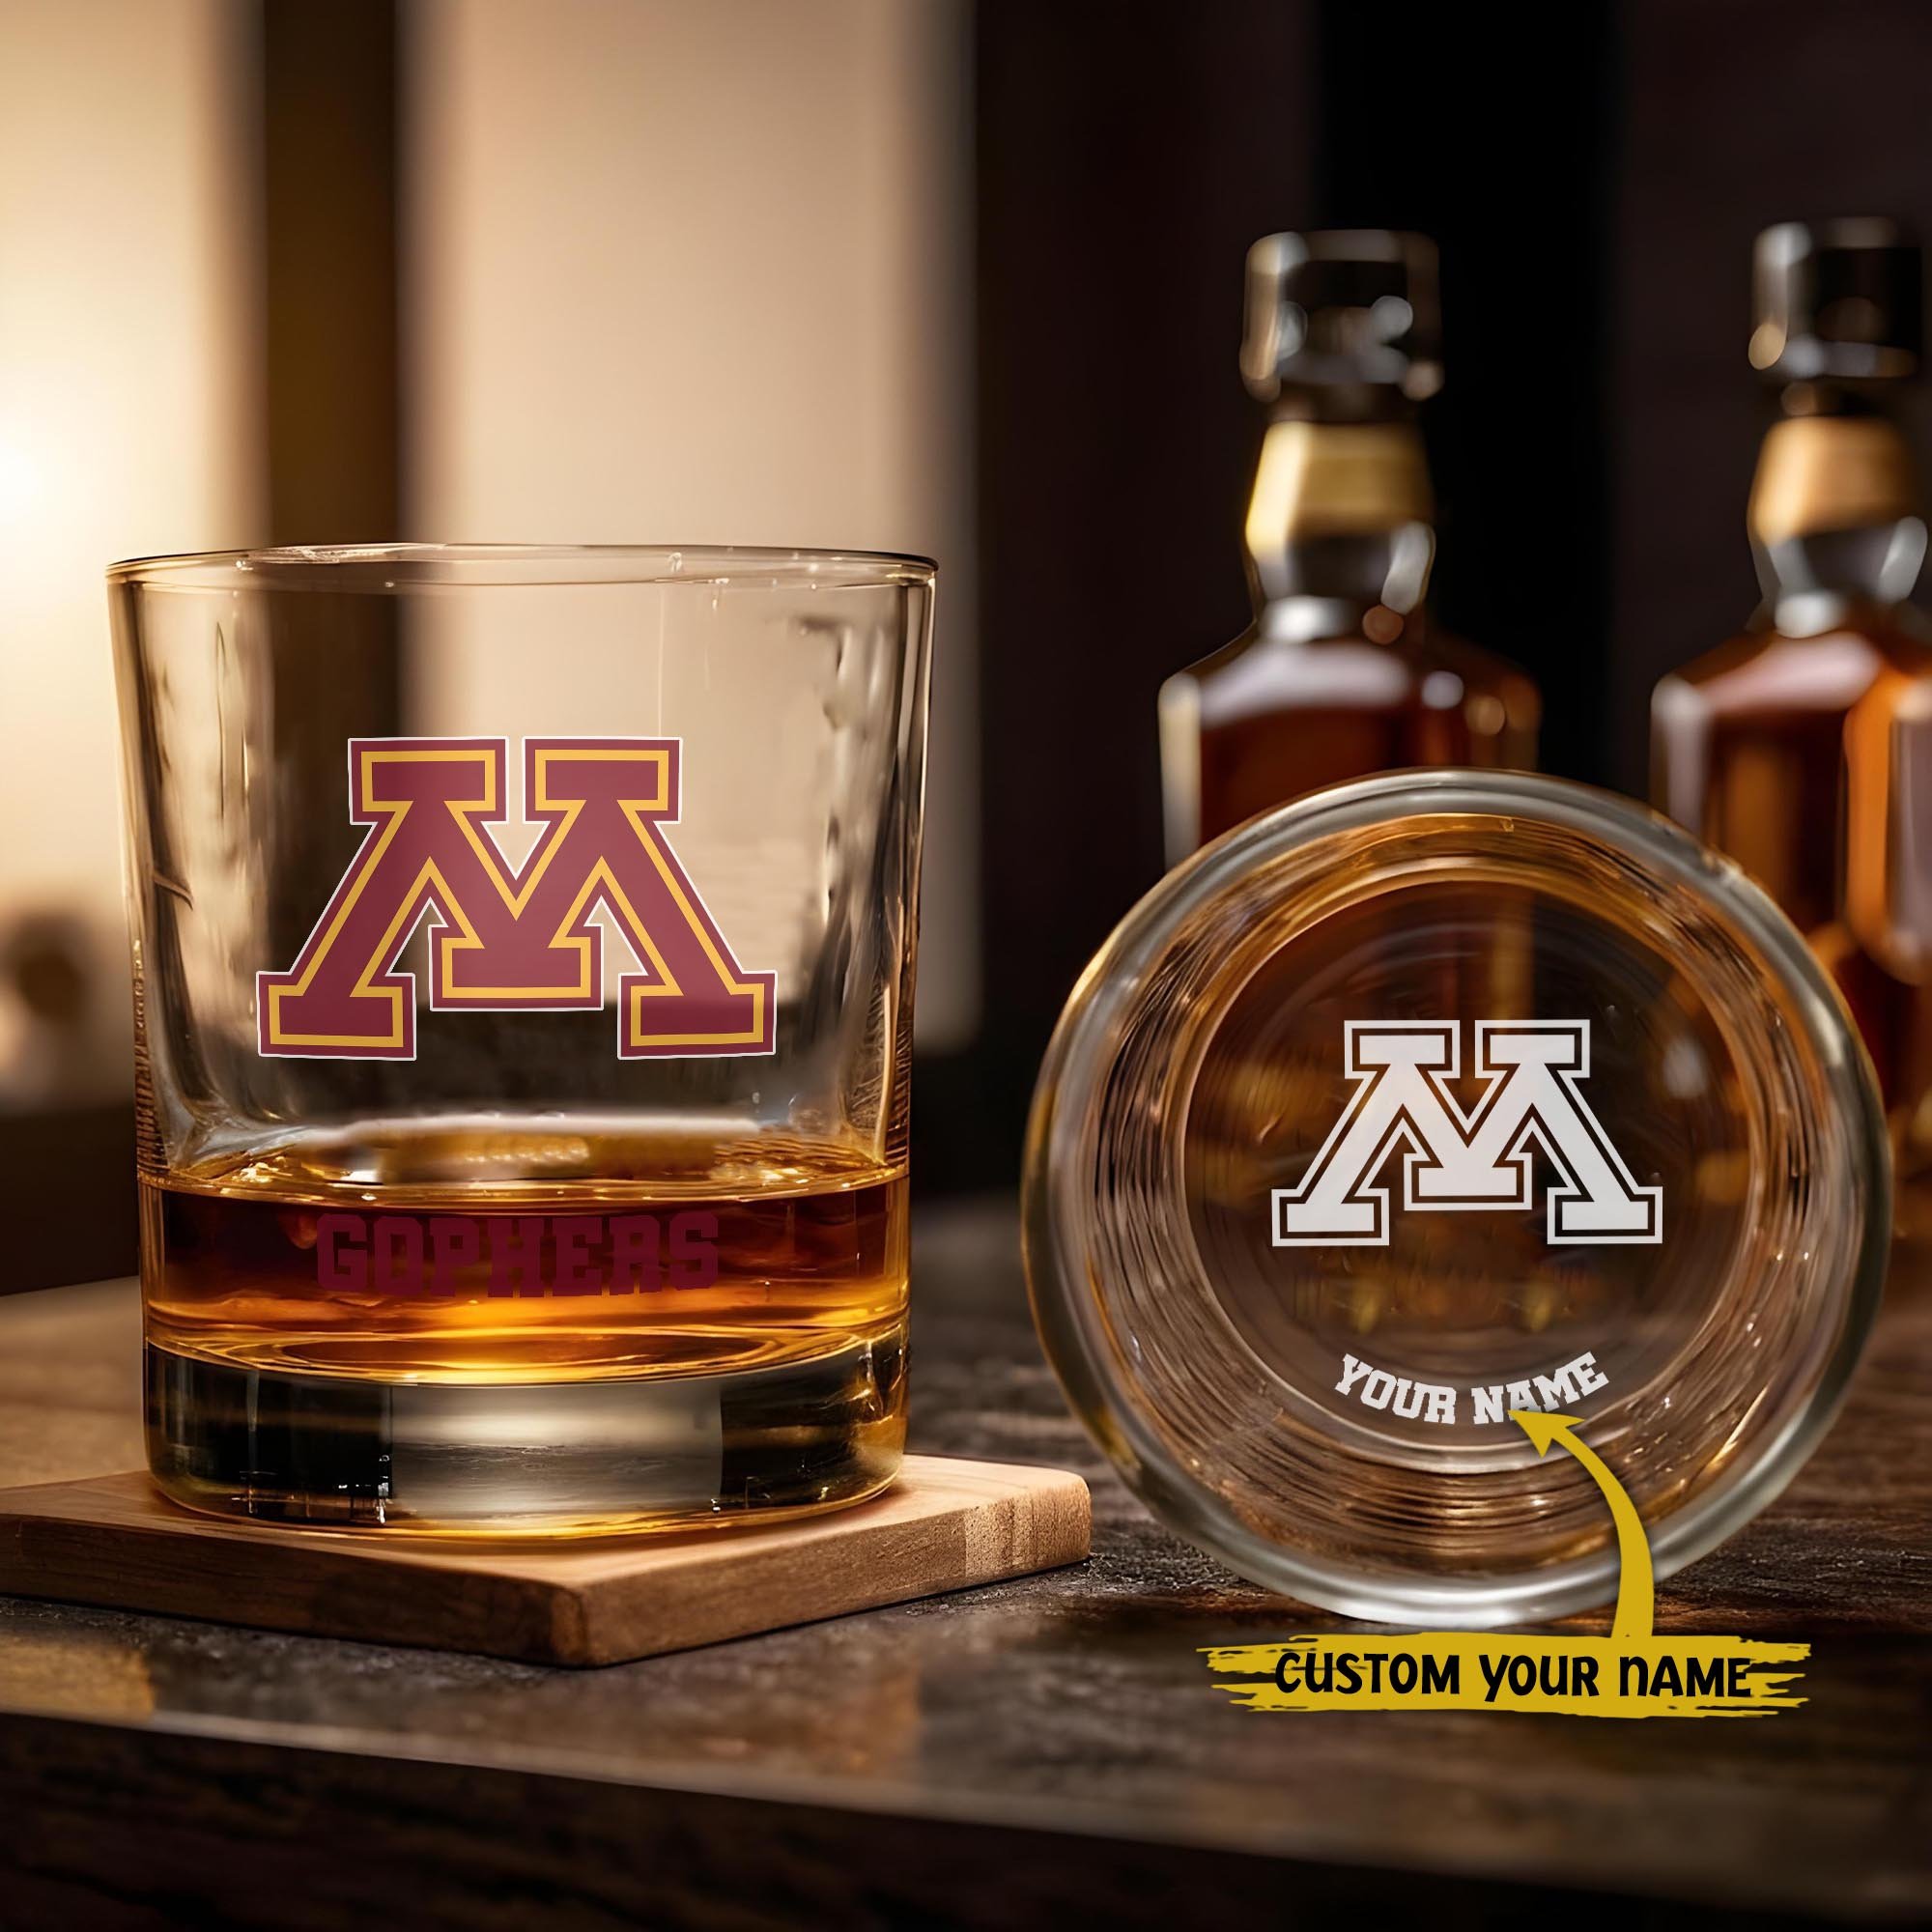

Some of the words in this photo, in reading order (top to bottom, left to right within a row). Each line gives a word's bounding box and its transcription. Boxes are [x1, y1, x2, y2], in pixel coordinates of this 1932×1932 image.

[257, 736, 779, 1061] M
[1271, 1019, 1663, 1247] M
[317, 1213, 719, 1298] GOPHERS
[1334, 1352, 1457, 1425] YOUR
[1471, 1351, 1609, 1425] NAME
